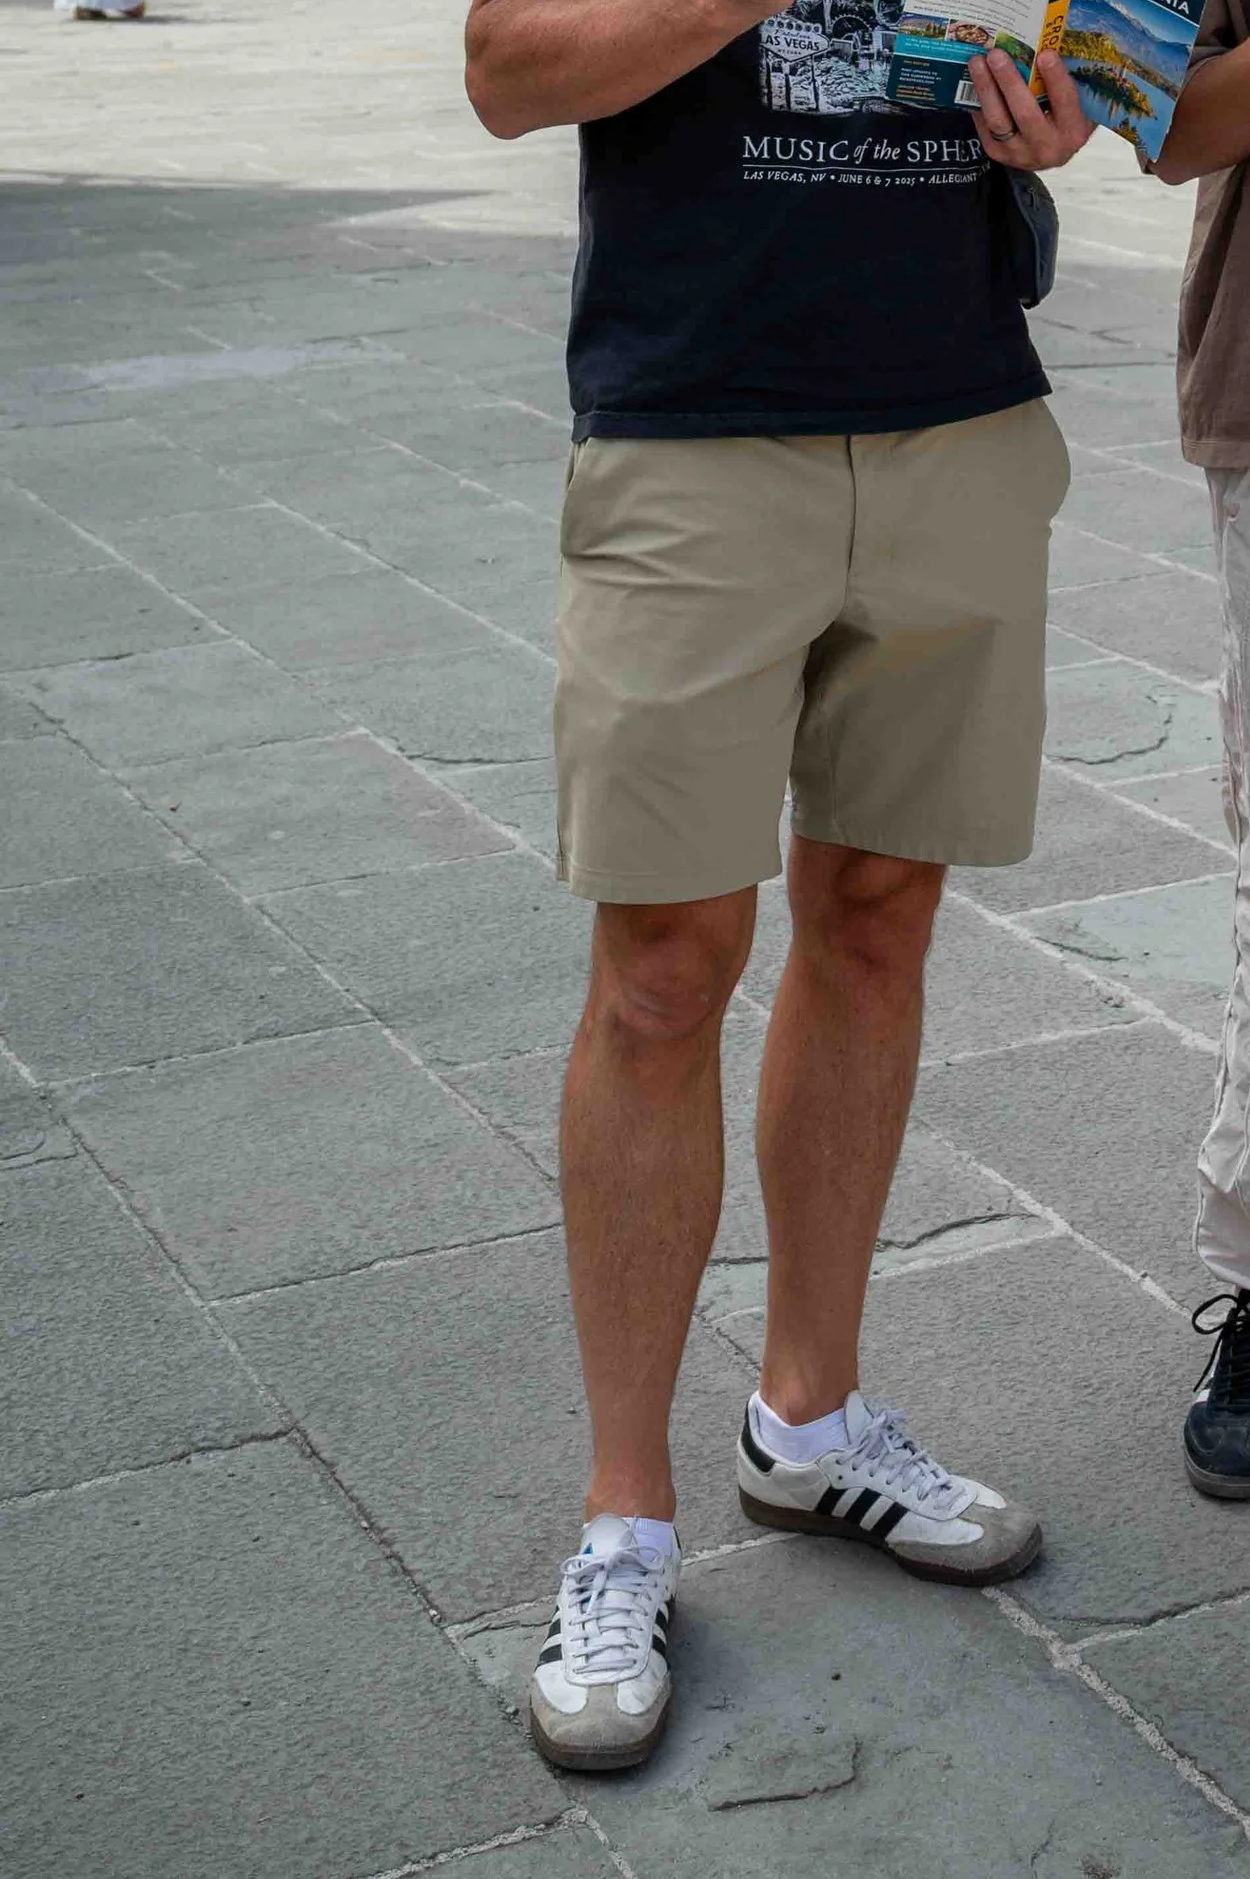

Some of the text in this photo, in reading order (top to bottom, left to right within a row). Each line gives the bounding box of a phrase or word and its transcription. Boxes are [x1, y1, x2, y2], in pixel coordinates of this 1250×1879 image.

[766, 34, 780, 46] AS
[784, 37, 819, 51] VEGAS
[743, 135, 982, 164] MUSIC of the SPHR
[743, 170, 764, 180] LAS
[767, 171, 807, 183] VEGAS,
[810, 172, 826, 182] NV
[838, 173, 863, 184] JUNE
[865, 175, 872, 185] 6
[874, 176, 881, 185] &
[884, 178, 891, 187] 7
[895, 177, 915, 187] 2025
